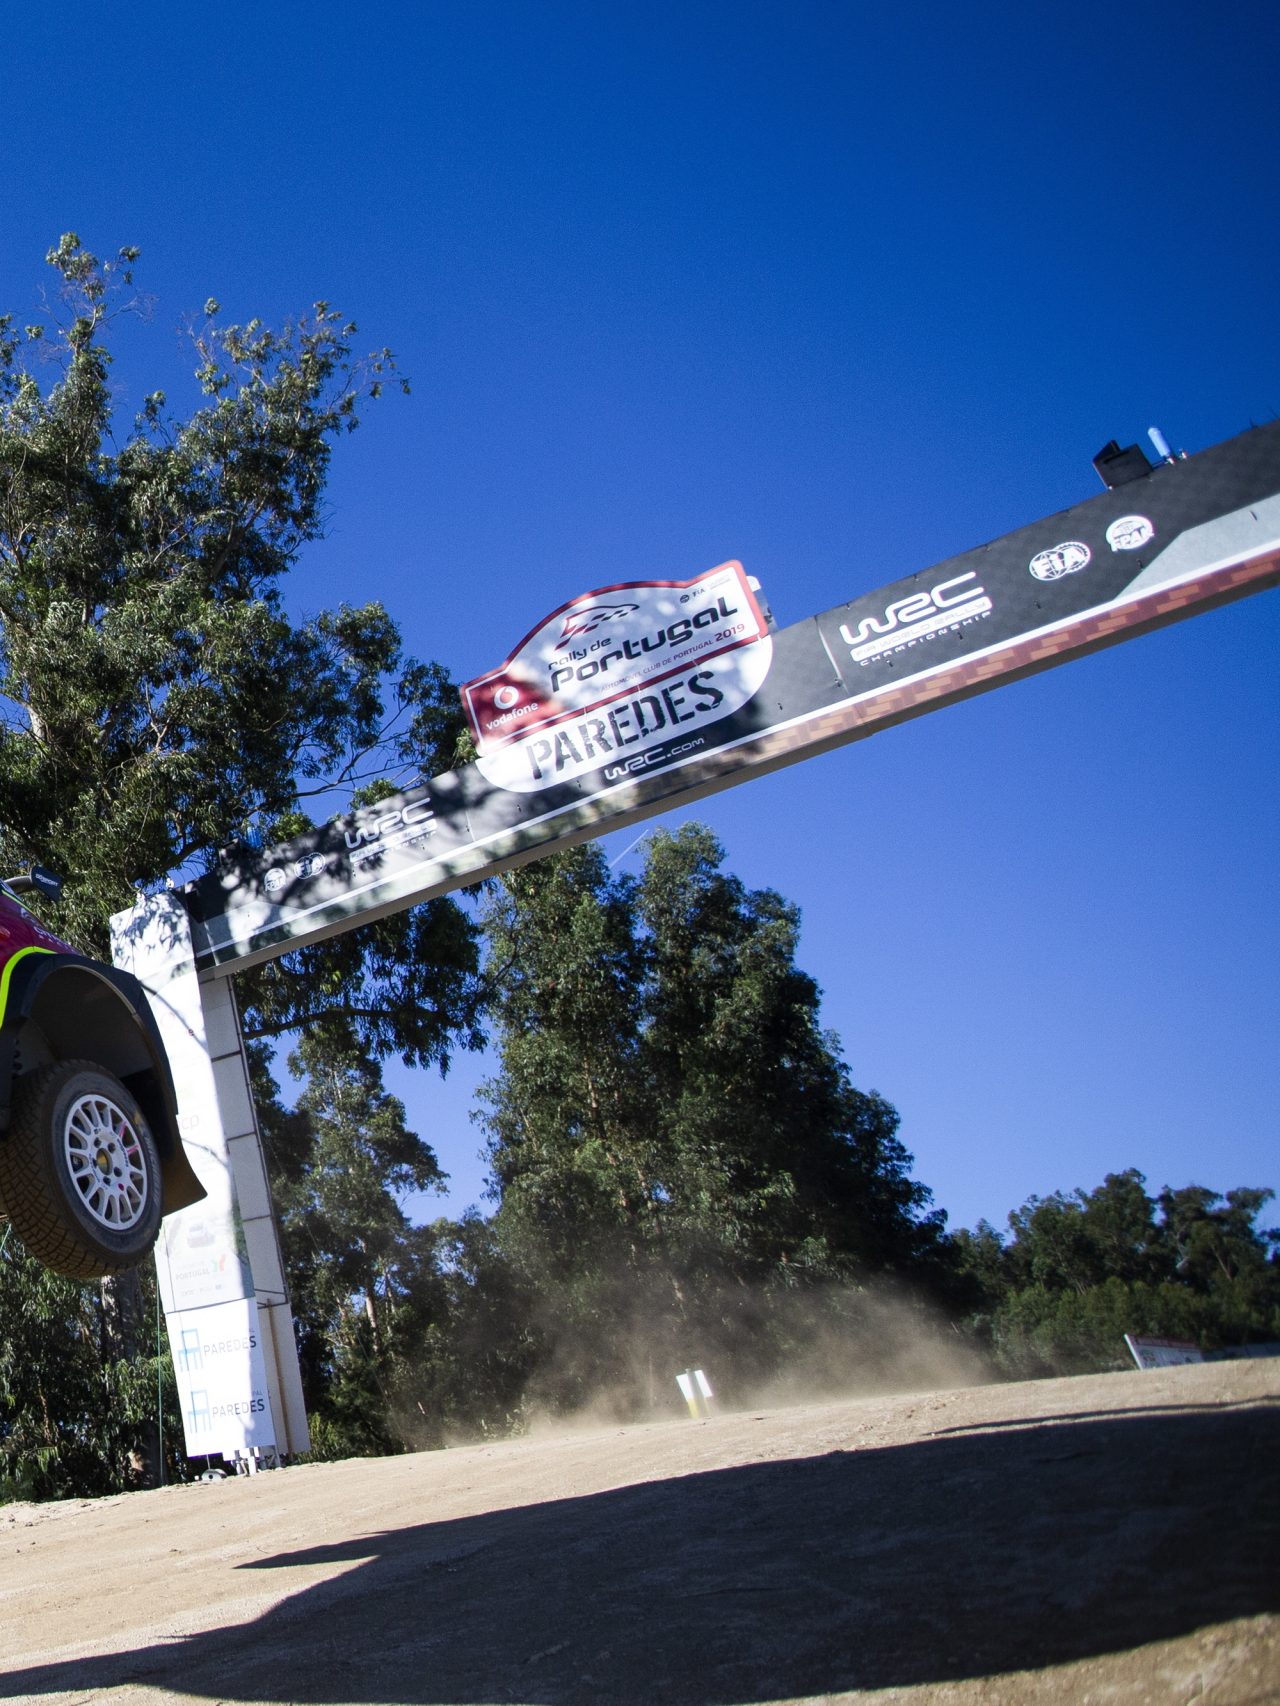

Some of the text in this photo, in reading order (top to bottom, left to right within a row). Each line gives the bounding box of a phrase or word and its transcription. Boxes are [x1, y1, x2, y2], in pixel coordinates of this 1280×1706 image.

[838, 570, 985, 645] WRC
[547, 636, 612, 671] rally de
[550, 596, 739, 694] Portugal
[662, 657, 673, 667] DE
[673, 639, 714, 661] PORTUGAL
[714, 623, 745, 643] 2019
[860, 610, 991, 666] CHAMPIONSHIP
[486, 701, 539, 731] vodafone
[525, 670, 725, 781] PAREDES
[344, 797, 434, 849] WRC
[203, 1335, 257, 1358] PAREDES
[212, 1398, 265, 1418] PAREDES
